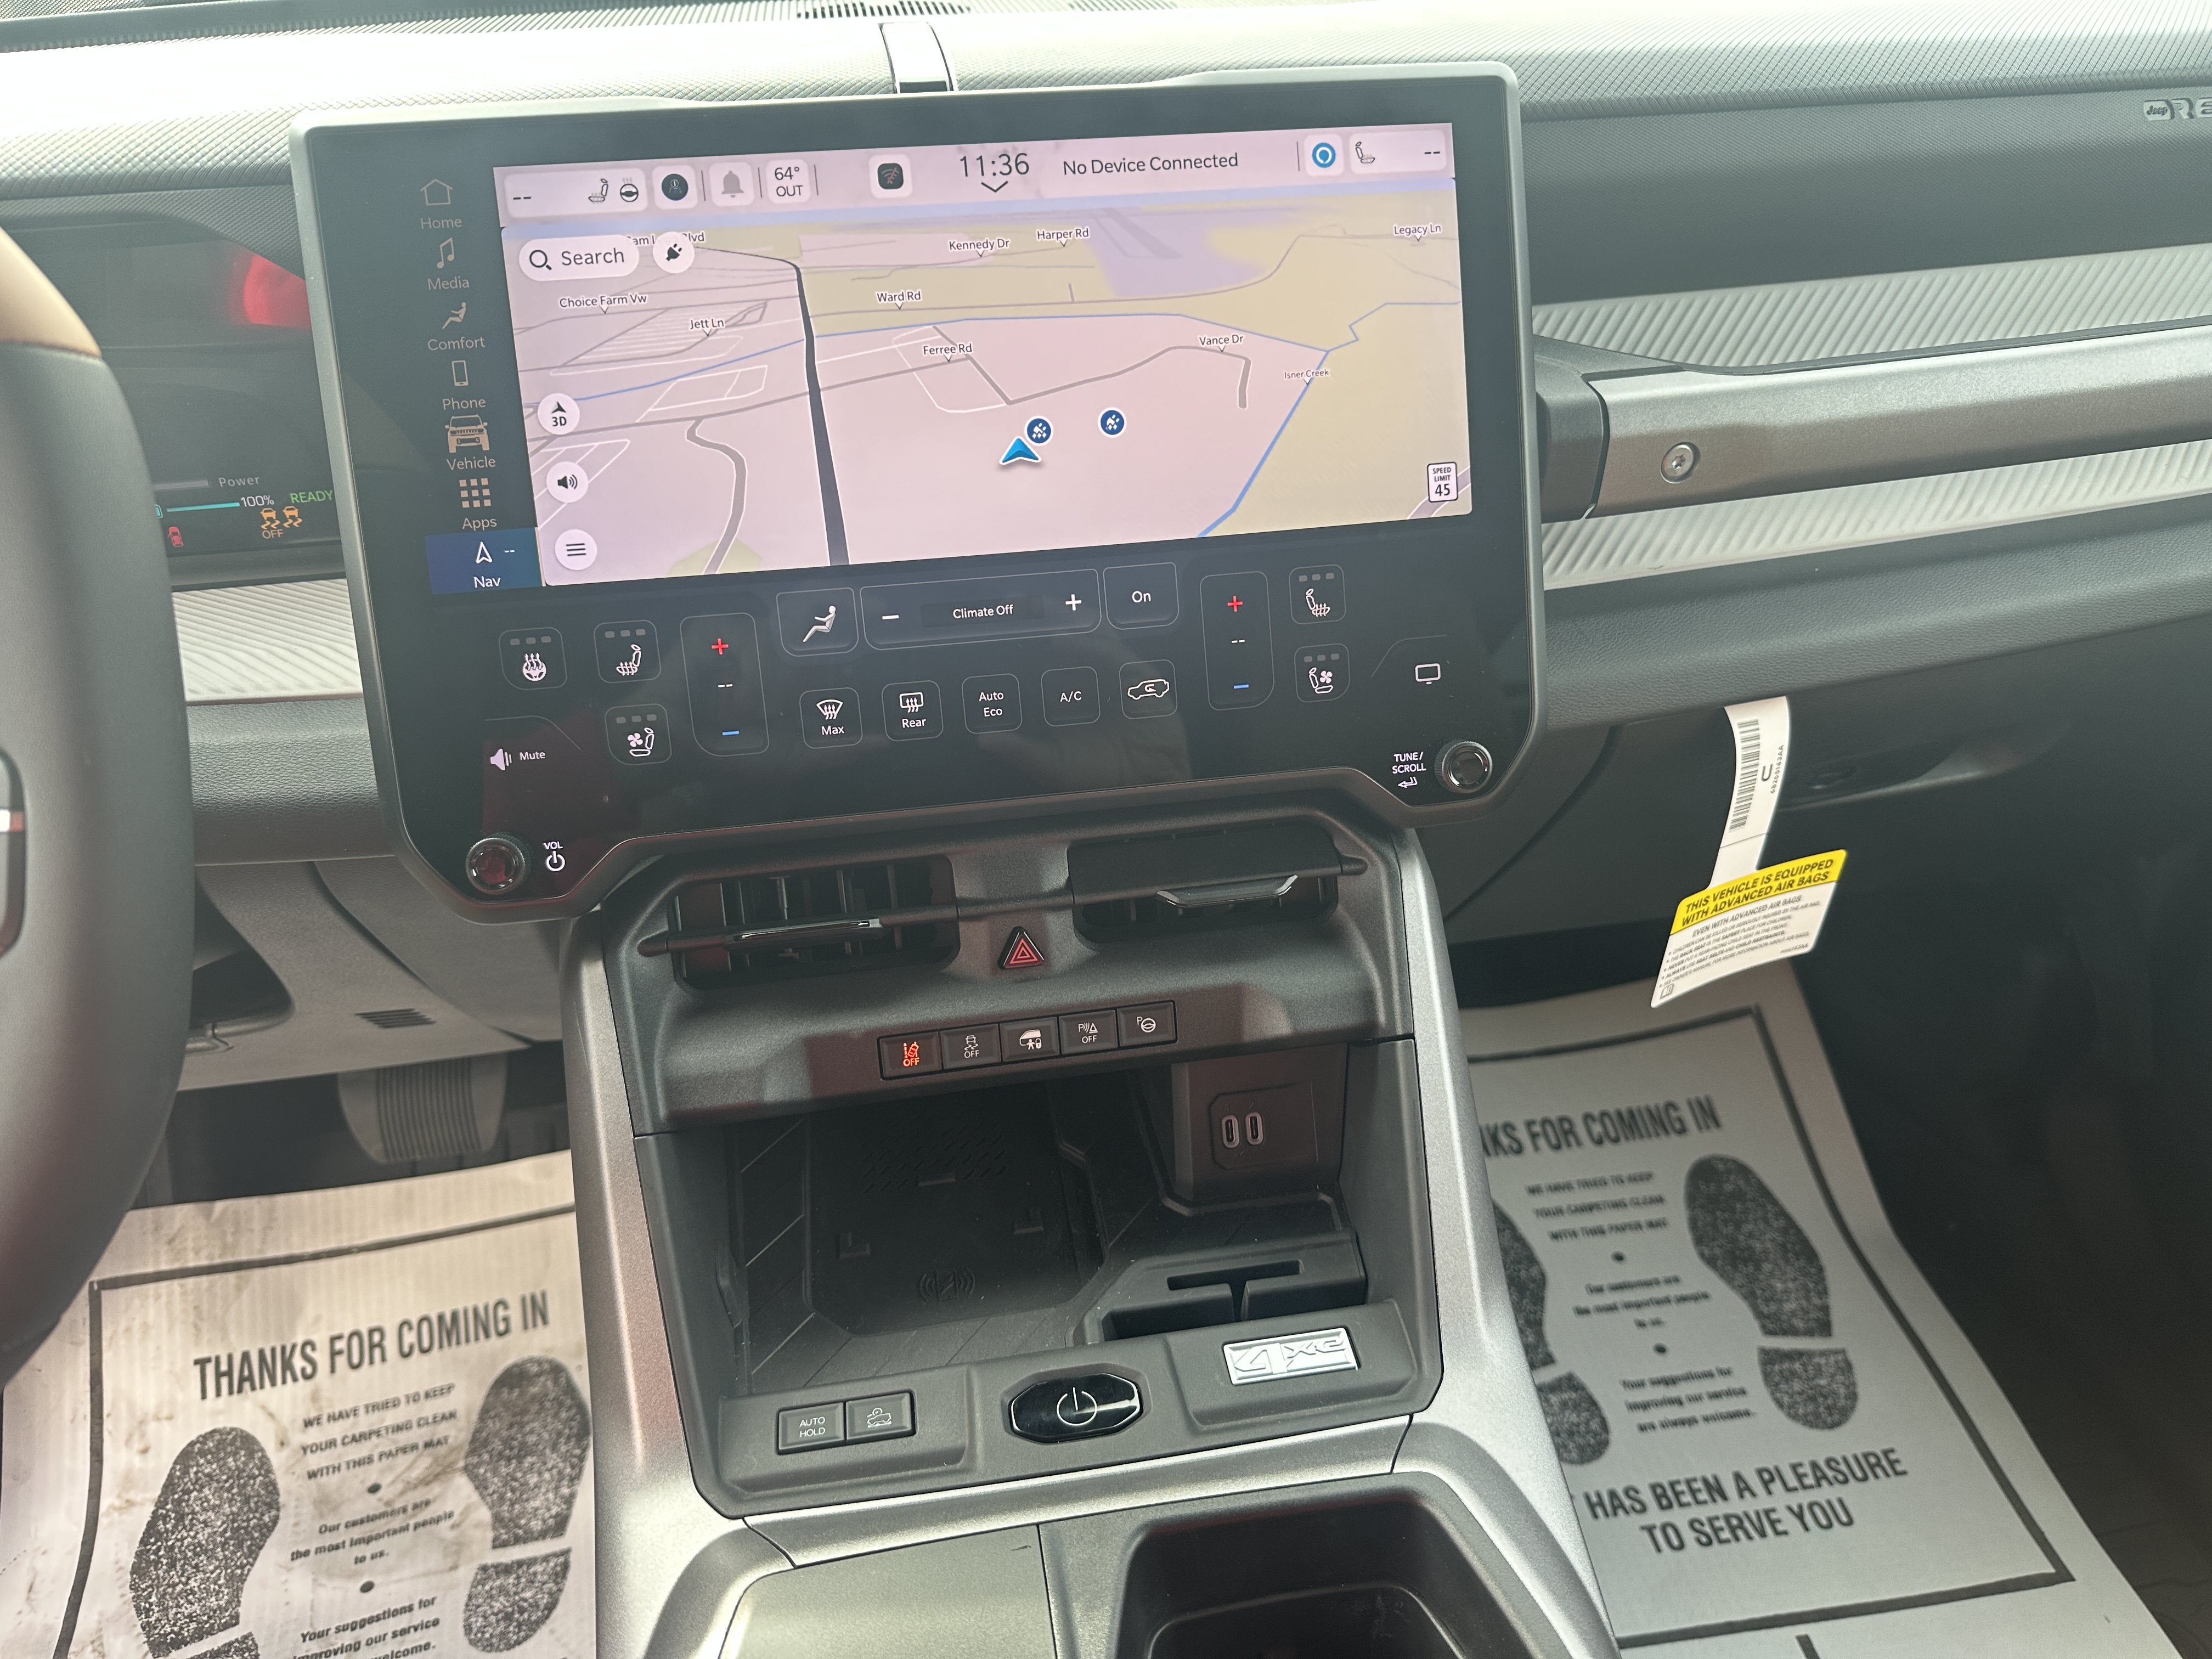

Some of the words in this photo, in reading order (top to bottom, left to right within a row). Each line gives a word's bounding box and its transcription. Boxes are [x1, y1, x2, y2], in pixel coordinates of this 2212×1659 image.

[960, 153, 1030, 177] 11:36
[1063, 161, 1087, 176] No
[1092, 158, 1146, 174] Device
[1149, 153, 1238, 171] Connected
[775, 166, 800, 180] 64°
[776, 184, 803, 197] OUT
[420, 217, 462, 230] Home
[1394, 224, 1427, 236] Legacy
[1431, 224, 1441, 233] Ln
[627, 236, 649, 245] am
[682, 232, 704, 242] lvd
[1037, 230, 1073, 240] Harper
[1075, 228, 1089, 238] Rd
[949, 239, 995, 251] Kennedy
[997, 238, 1010, 248] Dr
[561, 247, 625, 266] Search
[428, 276, 470, 291] Media
[560, 295, 597, 308] Choice
[600, 294, 628, 306] Farm
[630, 294, 647, 304] Vw
[877, 291, 905, 303] Ward
[907, 291, 921, 302] Rd
[690, 319, 709, 330] Jett
[712, 318, 724, 328] Ln
[427, 337, 486, 351] Comfort
[1199, 335, 1229, 346] Vance
[1232, 335, 1244, 344] Dr
[923, 343, 956, 356] Ferree
[958, 342, 973, 353] Rd
[1284, 370, 1304, 380] Isner
[1305, 368, 1329, 378] Creek
[442, 398, 486, 410] Phone
[551, 416, 567, 427] 3D
[446, 456, 496, 470] Vehicle
[218, 476, 260, 488] Power
[1435, 483, 1451, 497] 45
[240, 495, 275, 507] 100%
[290, 490, 334, 504] READY
[462, 517, 497, 531] Apps
[262, 529, 284, 539] OFF
[473, 576, 501, 588] Nav
[1131, 590, 1151, 603] On
[952, 605, 994, 620] Climate
[996, 605, 1014, 617] Off
[979, 690, 1005, 702] Auto
[1059, 690, 1082, 703] A/C
[983, 706, 1003, 717] Eco
[901, 716, 926, 729] Rear
[821, 724, 845, 736] Max
[519, 749, 546, 761] Mute
[1393, 751, 1424, 763] TUNE/
[1391, 761, 1427, 774] SCROLL
[1760, 764, 1773, 781] U
[544, 841, 563, 850] VOL
[1685, 895, 1710, 915] THIS
[1712, 879, 1758, 902] VEHICLE
[1760, 873, 1773, 885] IS
[1774, 859, 1834, 882] EQUIPPED
[1681, 907, 1710, 927] WITH
[1710, 886, 1773, 915] ADVANCED
[1774, 879, 1795, 893] AIR
[1797, 871, 1830, 887] BAGS
[1692, 923, 1710, 938] EVEN
[1711, 917, 1729, 929] WITH
[1729, 905, 1768, 923] ADVANCED
[1768, 900, 1782, 910] AIR
[1081, 1035, 1097, 1043] OFF
[964, 1049, 980, 1059] OFF
[902, 1057, 920, 1067] OFF
[1523, 1115, 1582, 1153] FOR
[1582, 1099, 1688, 1146] COMING
[1687, 1094, 1722, 1131] IN
[193, 1339, 318, 1400] THANKS
[329, 1324, 386, 1374] FOR
[397, 1297, 510, 1358] COMING
[520, 1290, 549, 1330] IN
[302, 1413, 323, 1429] WE
[326, 1406, 360, 1423] HAVE
[363, 1396, 401, 1415] TRIED
[404, 1391, 421, 1405] TO
[424, 1383, 455, 1400] KEEP
[799, 1415, 826, 1428] AUTO
[301, 1437, 337, 1456] YOUR
[341, 1419, 413, 1447] CARPETING
[416, 1408, 458, 1427] CLEAN
[799, 1426, 826, 1438] HOLD
[307, 1463, 341, 1480] WITH
[345, 1454, 375, 1470] THIS
[377, 1442, 419, 1463] PAPER
[422, 1434, 451, 1449] MAT
[1582, 1485, 1647, 1520] HAS
[1648, 1474, 1729, 1512] BEEN
[1730, 1470, 1756, 1500] A
[1756, 1447, 1908, 1497] PLEASURE
[318, 1522, 341, 1534] Our
[344, 1504, 408, 1529] customers
[411, 1498, 431, 1511] are
[1639, 1520, 1686, 1554] TO
[1687, 1507, 1788, 1548] SERVE
[1787, 1497, 1854, 1533] YOU
[290, 1548, 311, 1561] the
[314, 1539, 346, 1555] most
[349, 1523, 410, 1547] important
[413, 1510, 454, 1532] people
[354, 1554, 366, 1565] to
[370, 1549, 390, 1561] us.
[300, 1627, 331, 1643] Your
[334, 1602, 414, 1635] suggestions
[417, 1596, 437, 1610] for
[365, 1632, 388, 1647] our
[391, 1616, 439, 1639] service
